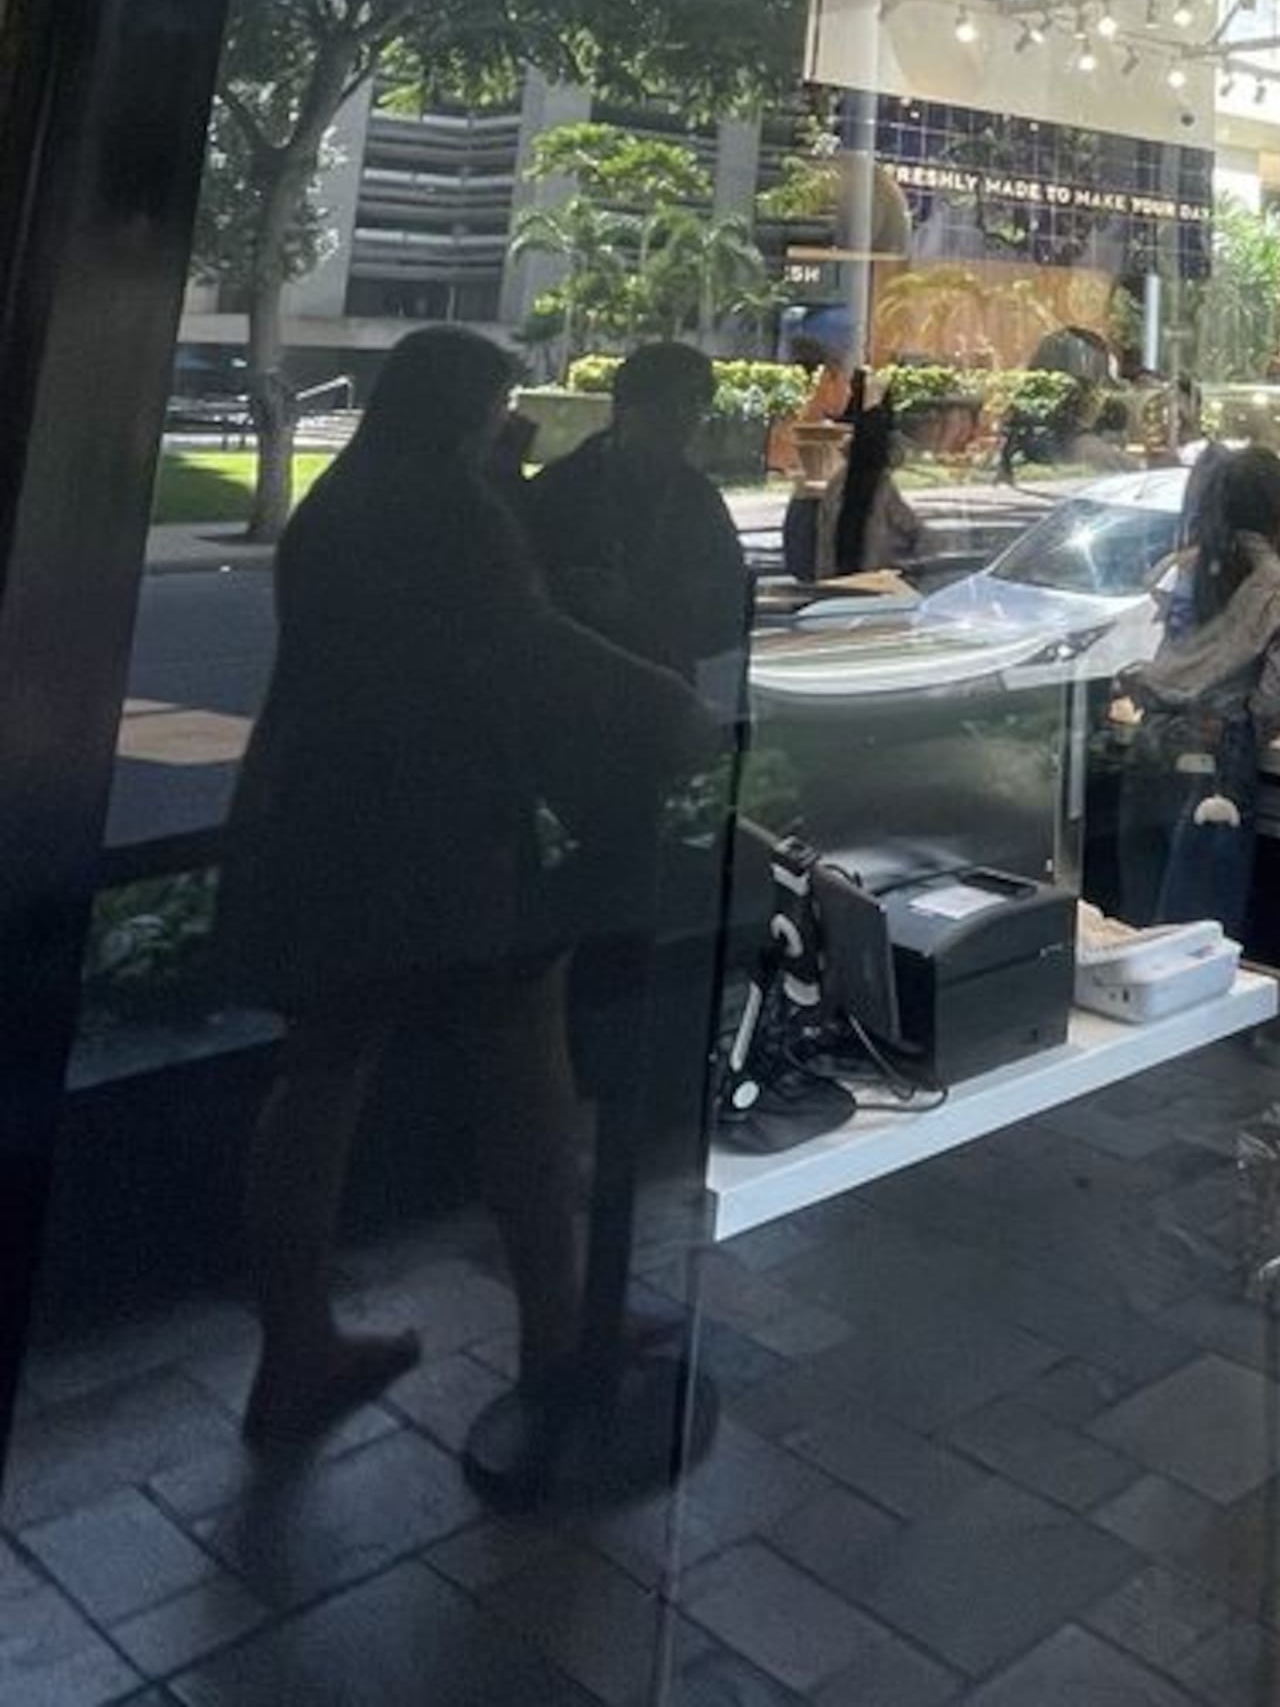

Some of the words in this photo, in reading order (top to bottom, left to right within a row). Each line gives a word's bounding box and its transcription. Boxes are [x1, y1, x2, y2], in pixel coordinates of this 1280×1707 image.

[883, 162, 978, 192] FRESHLY
[985, 177, 1042, 200] MADE
[1045, 183, 1072, 204] TO
[1073, 190, 1127, 211] MAKE
[1130, 196, 1177, 217] YOUR
